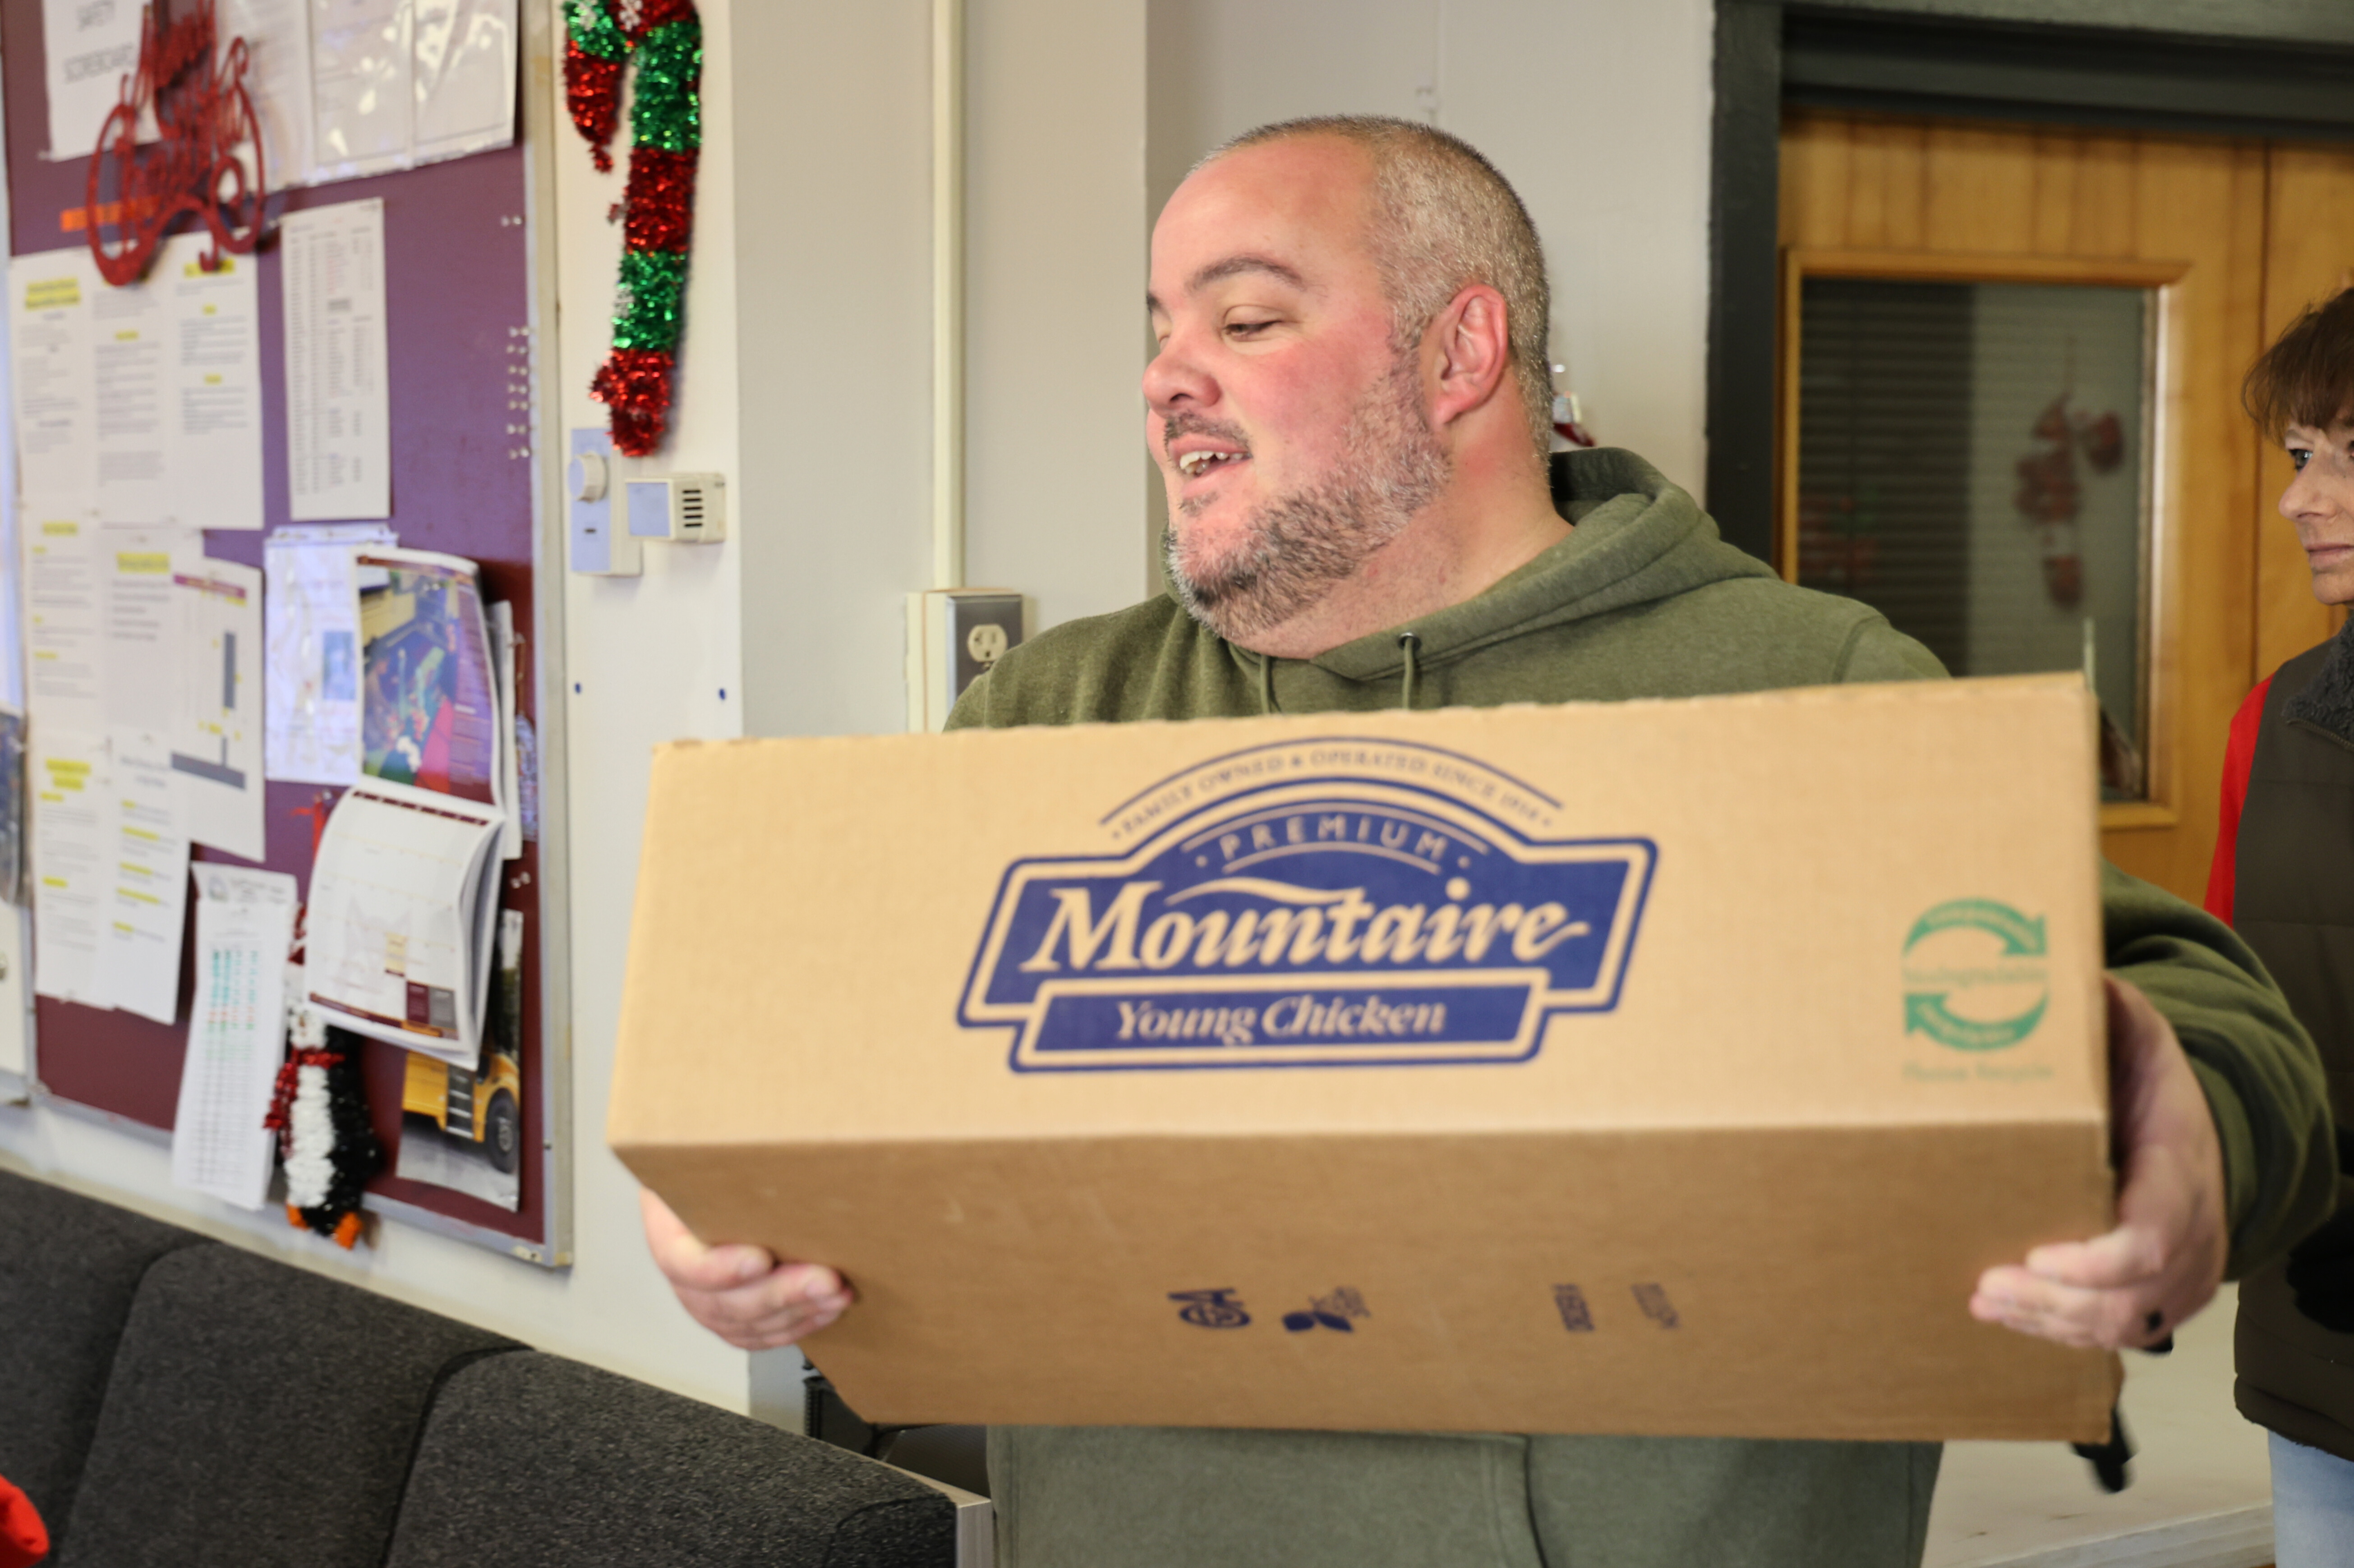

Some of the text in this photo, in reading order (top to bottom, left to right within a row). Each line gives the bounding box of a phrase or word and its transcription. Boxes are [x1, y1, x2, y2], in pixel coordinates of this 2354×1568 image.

[1198, 754, 1284, 792] OWNED
[1309, 749, 1429, 774] OPERATED
[1431, 761, 1497, 800] SINCE
[1219, 813, 1448, 861] PREMIUM
[1018, 876, 1592, 972] Mountaire
[1116, 993, 1446, 1047] Young Chicken
